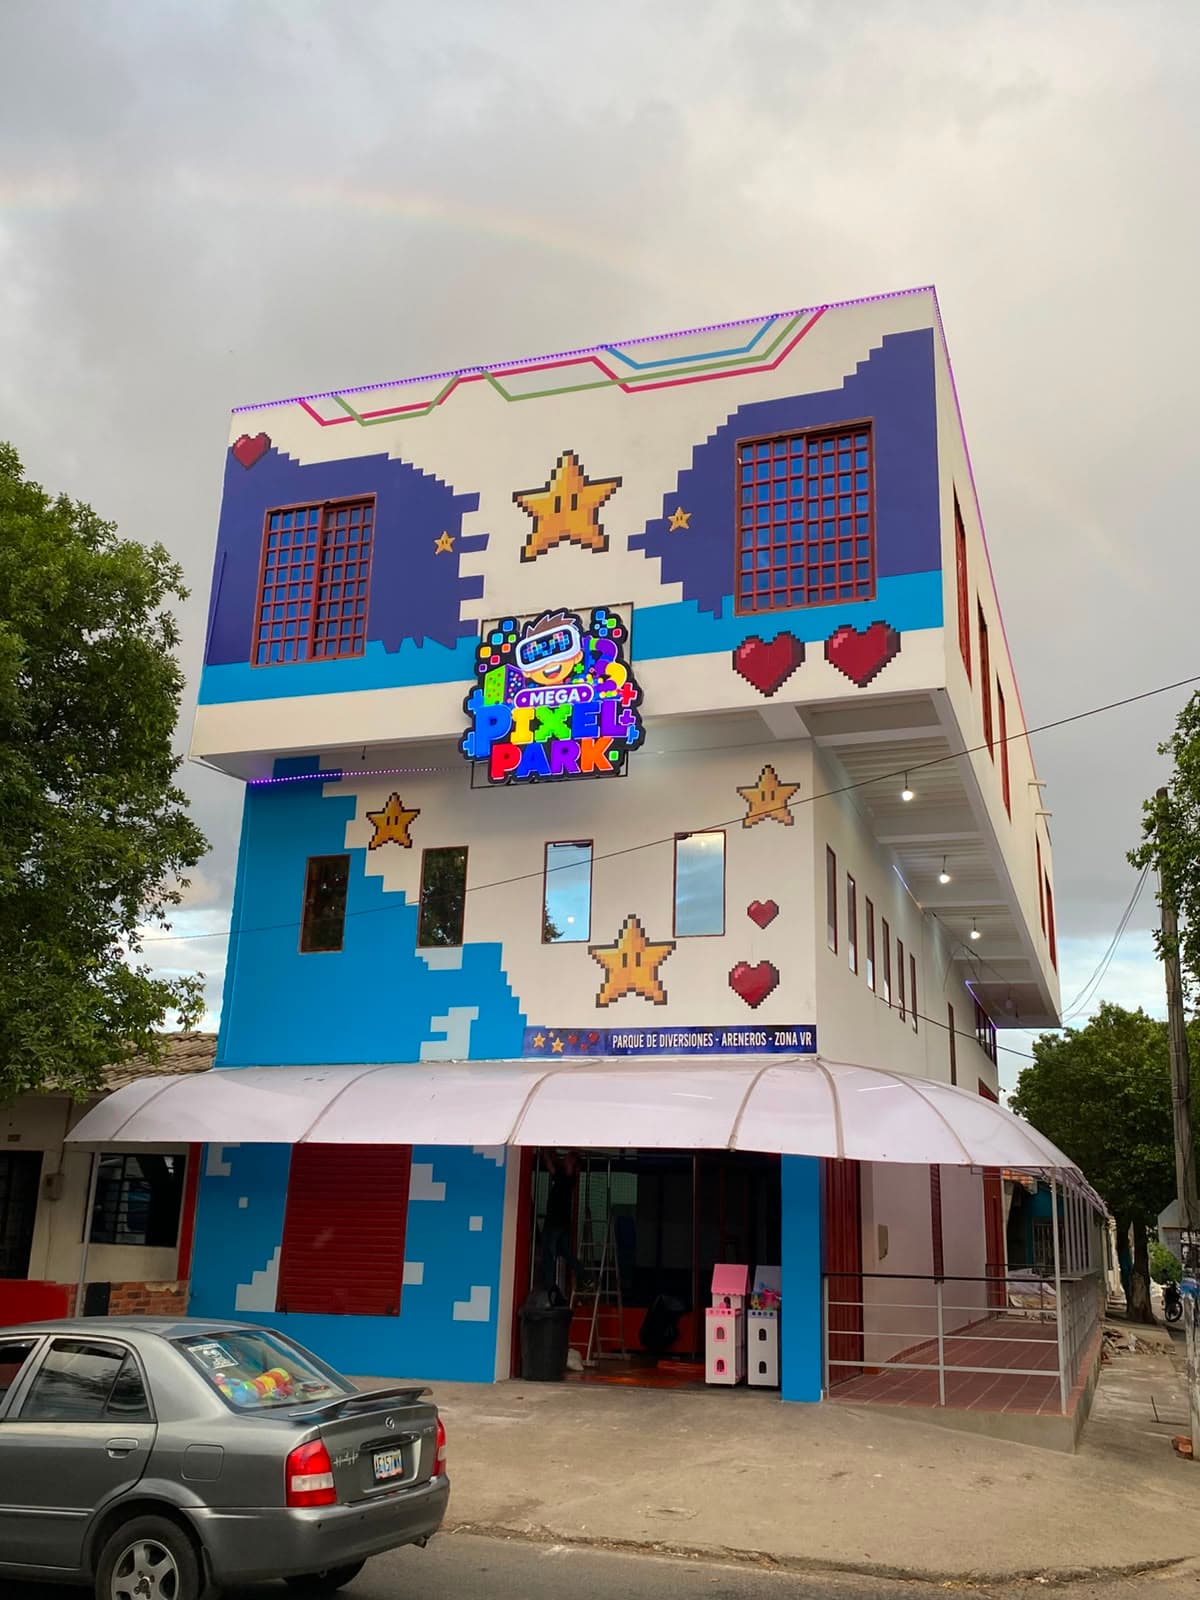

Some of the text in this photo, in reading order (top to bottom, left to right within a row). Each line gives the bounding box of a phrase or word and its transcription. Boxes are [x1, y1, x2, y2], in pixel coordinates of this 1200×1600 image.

[529, 687, 581, 706] MEGA
[475, 700, 629, 758] PIXEL
[490, 736, 615, 780] PARK
[612, 1034, 645, 1049] PARQUE
[646, 1033, 658, 1048] DE
[659, 1032, 714, 1048] DIVERSIONES
[721, 1031, 767, 1047] ARENEROS
[774, 1031, 799, 1046] ZONA
[799, 1031, 813, 1046] VR
